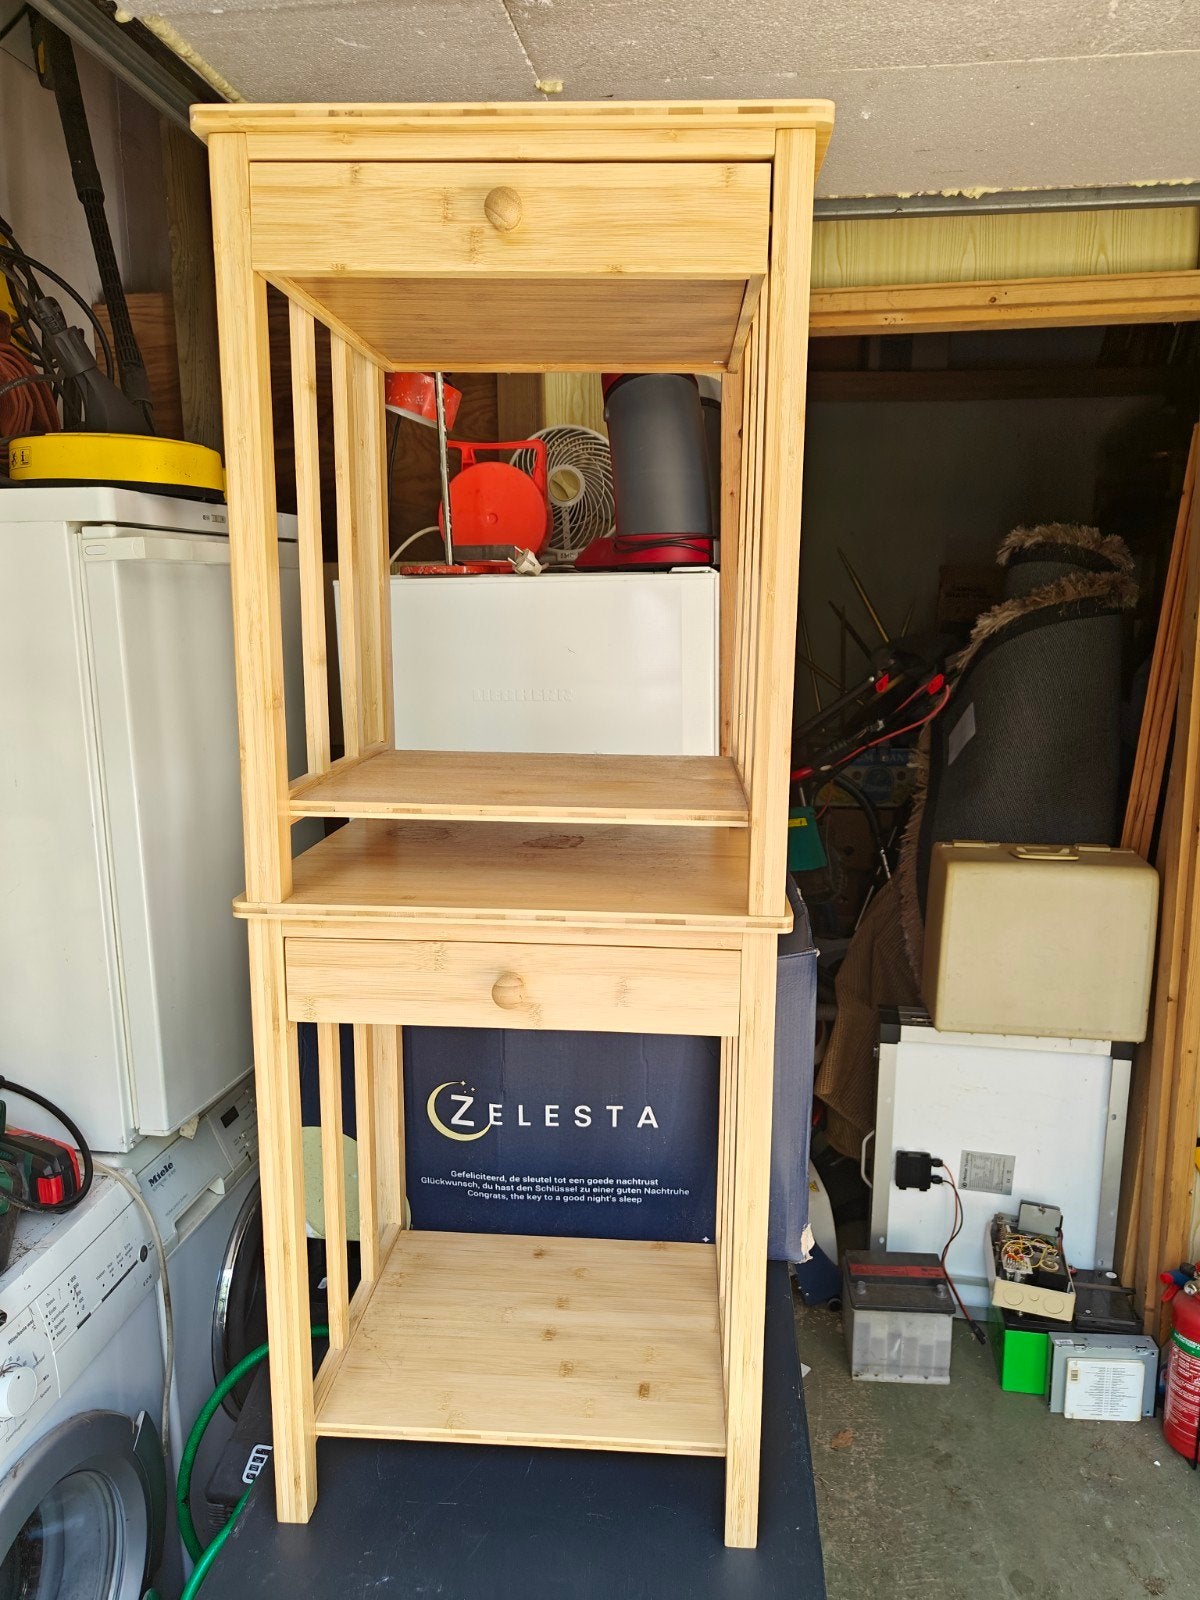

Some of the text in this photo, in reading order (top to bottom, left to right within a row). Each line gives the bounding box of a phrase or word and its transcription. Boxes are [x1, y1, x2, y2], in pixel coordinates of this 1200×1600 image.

[450, 1094, 659, 1129] ZELESTA
[148, 1160, 175, 1188] Miele
[450, 1170, 508, 1183] Gefeliciteerd,
[509, 1175, 520, 1183] de
[522, 1175, 552, 1184] sleutel
[554, 1176, 567, 1184] tot
[587, 1177, 614, 1186] goede
[616, 1177, 659, 1186] nachtrust
[420, 1176, 480, 1189] Glückwunsch,
[482, 1182, 493, 1190] du
[495, 1183, 514, 1191] hast
[516, 1184, 533, 1192] den
[535, 1184, 578, 1192] Schlüssel
[592, 1186, 614, 1194] einer
[616, 1187, 642, 1195] guten
[644, 1187, 690, 1195] Nachtruhe
[467, 1189, 509, 1201] Congrats,
[510, 1192, 525, 1200] the
[526, 1193, 541, 1202] key
[544, 1193, 553, 1201] to
[563, 1194, 585, 1202] good
[587, 1194, 617, 1204] night's
[618, 1195, 643, 1204] sleep
